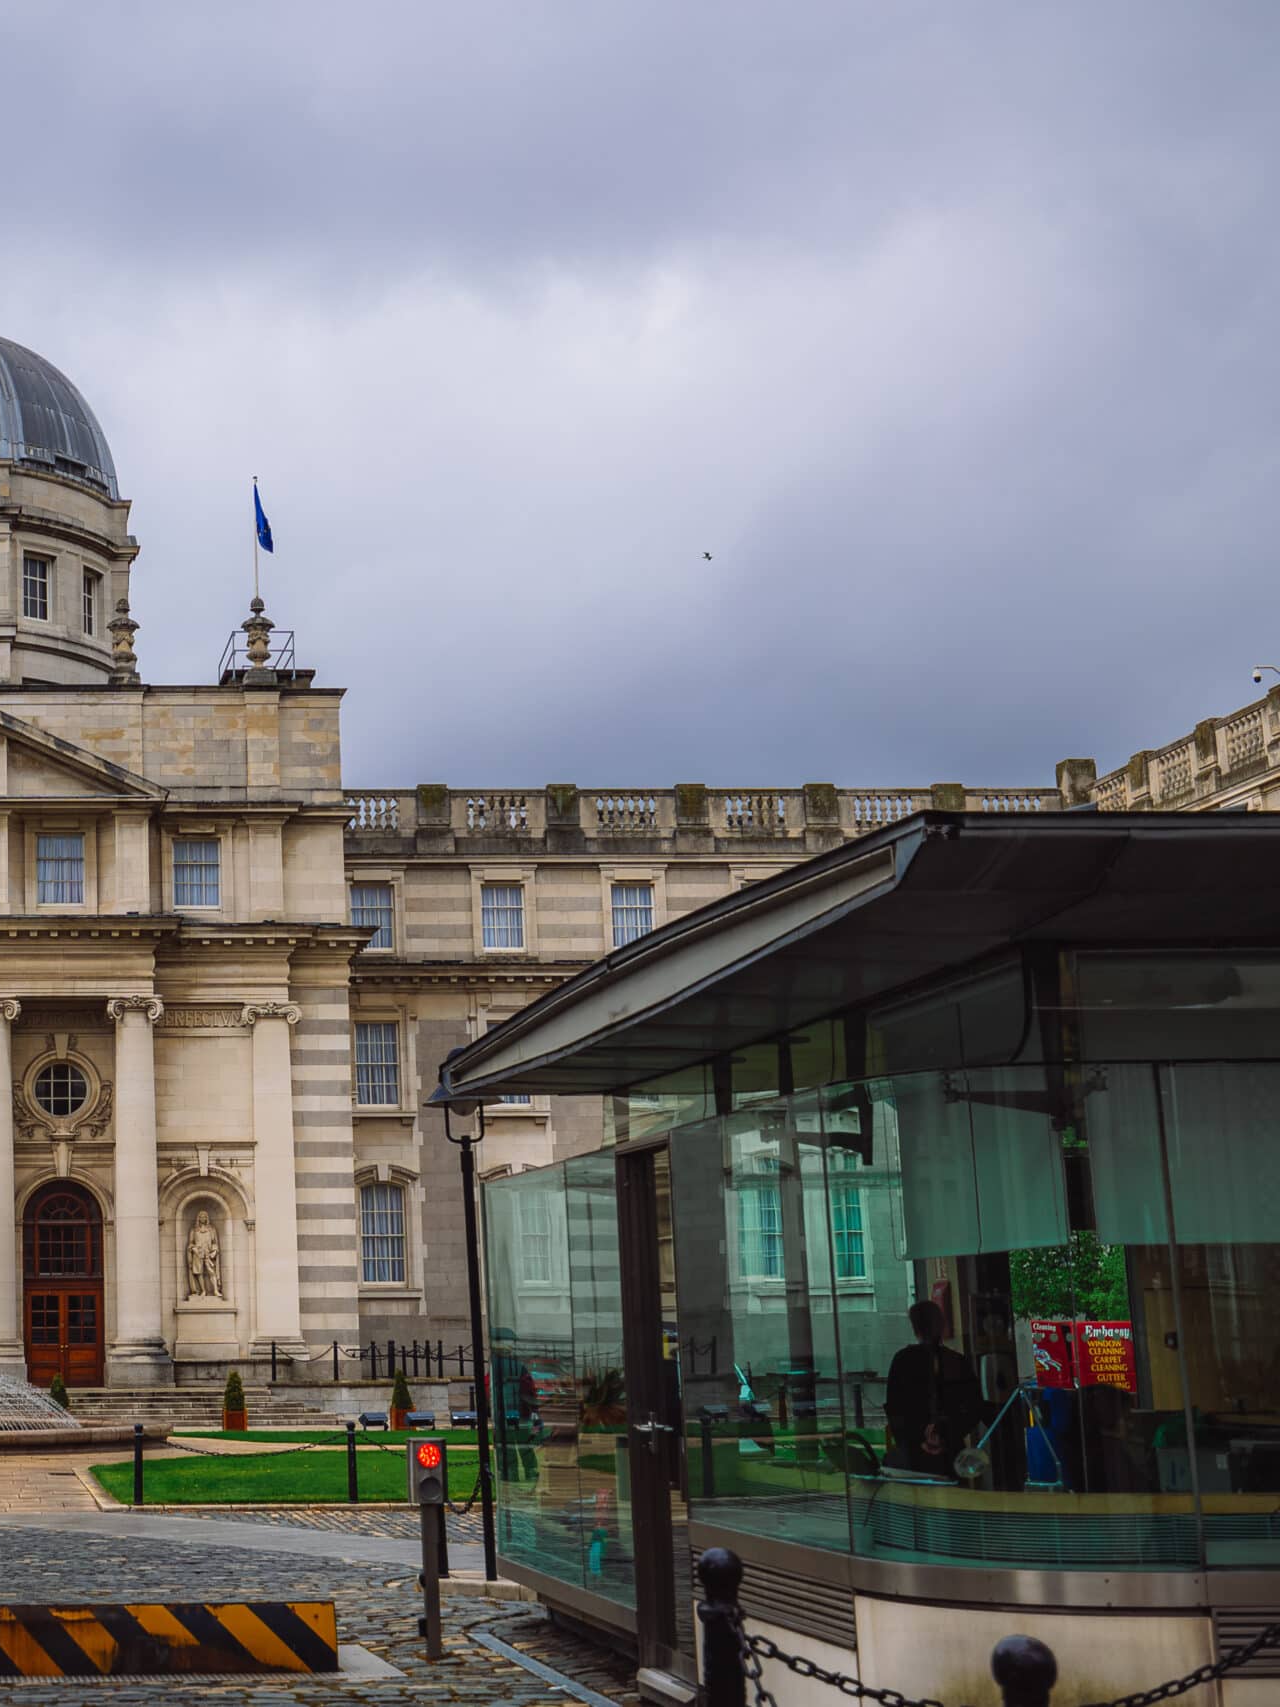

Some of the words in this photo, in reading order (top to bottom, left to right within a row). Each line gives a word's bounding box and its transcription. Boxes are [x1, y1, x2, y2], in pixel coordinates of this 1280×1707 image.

[165, 1010, 243, 1026] ERFECTVM
[1091, 1364, 1128, 1372] CLEANING
[1097, 1373, 1126, 1381] GUTTER
